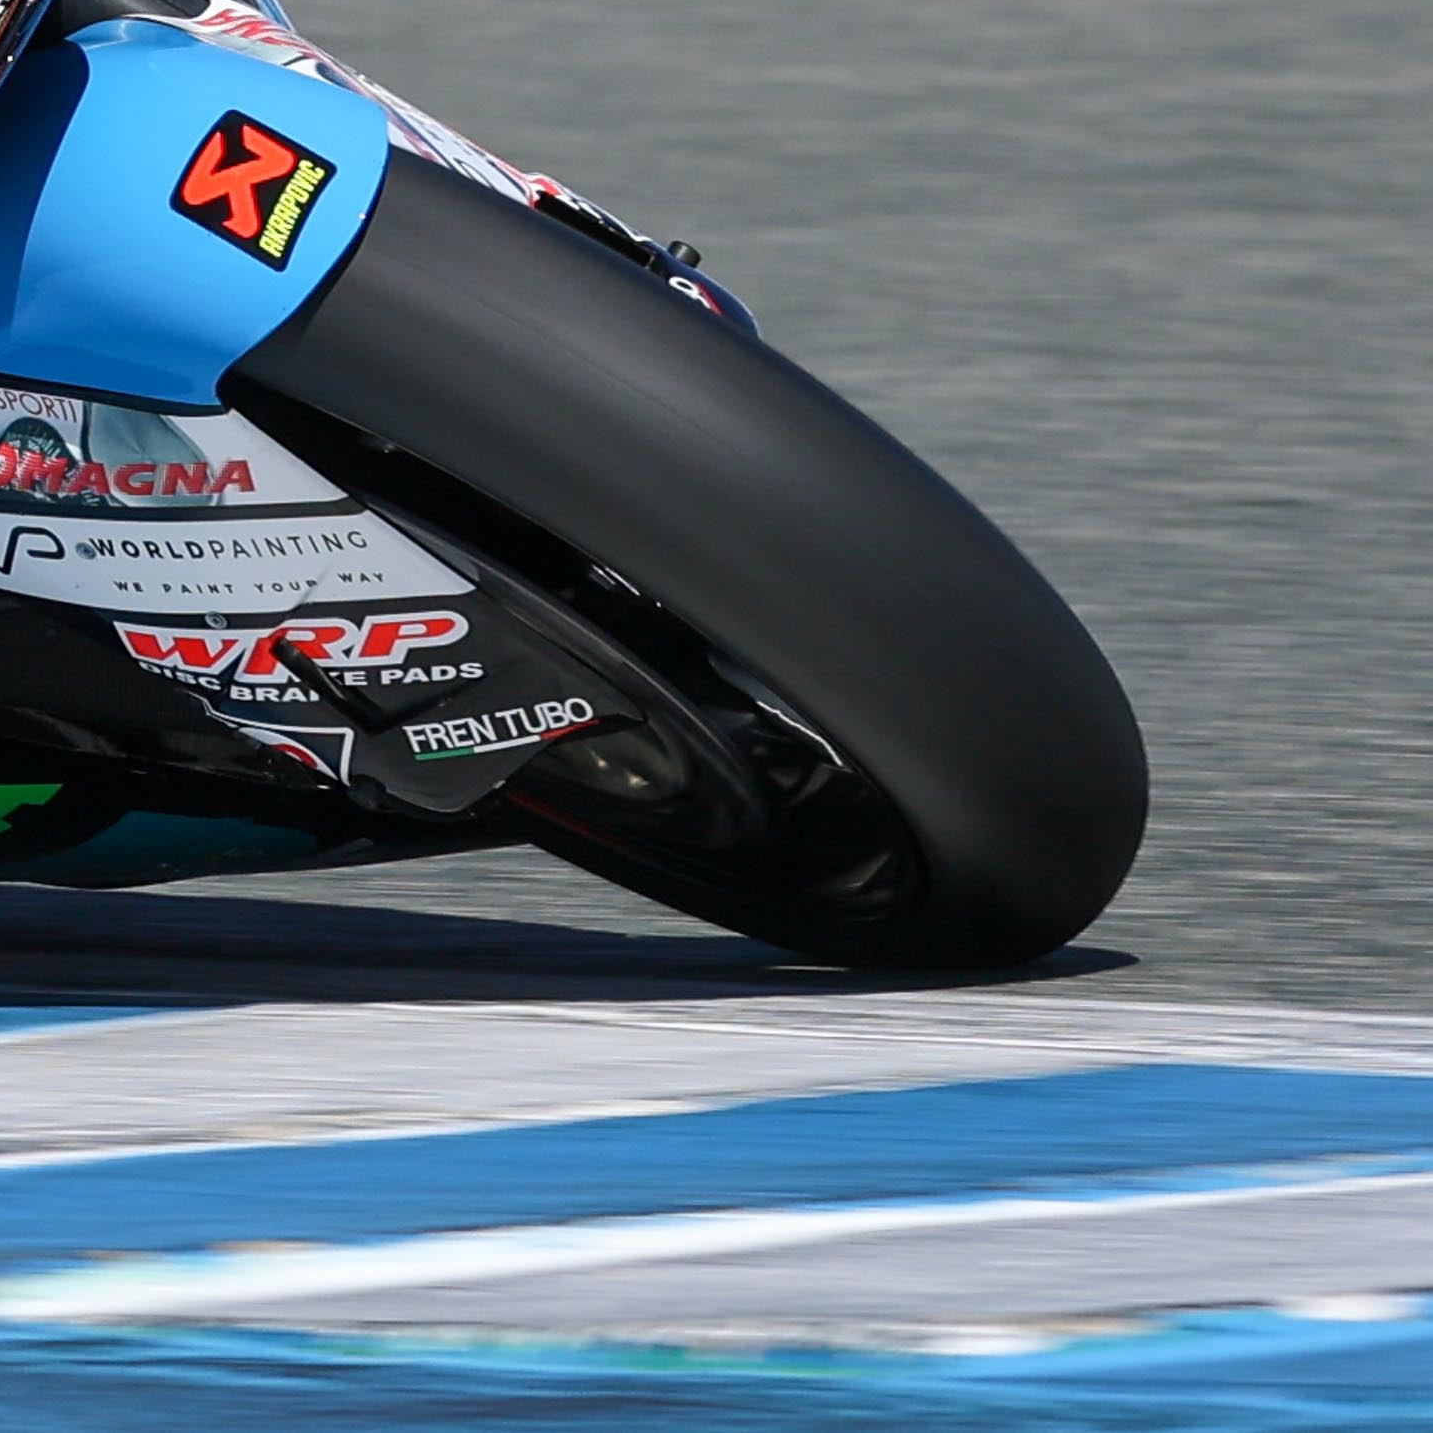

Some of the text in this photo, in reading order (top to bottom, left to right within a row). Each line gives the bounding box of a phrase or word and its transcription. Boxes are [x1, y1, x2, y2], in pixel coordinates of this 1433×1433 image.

[113, 580, 144, 594] WE
[162, 582, 234, 596] PAINT
[338, 572, 386, 586] WAY
[119, 614, 462, 679] WRP
[137, 660, 223, 692] DISC
[381, 662, 485, 686] PADS
[403, 696, 595, 755] FREN TUBO
